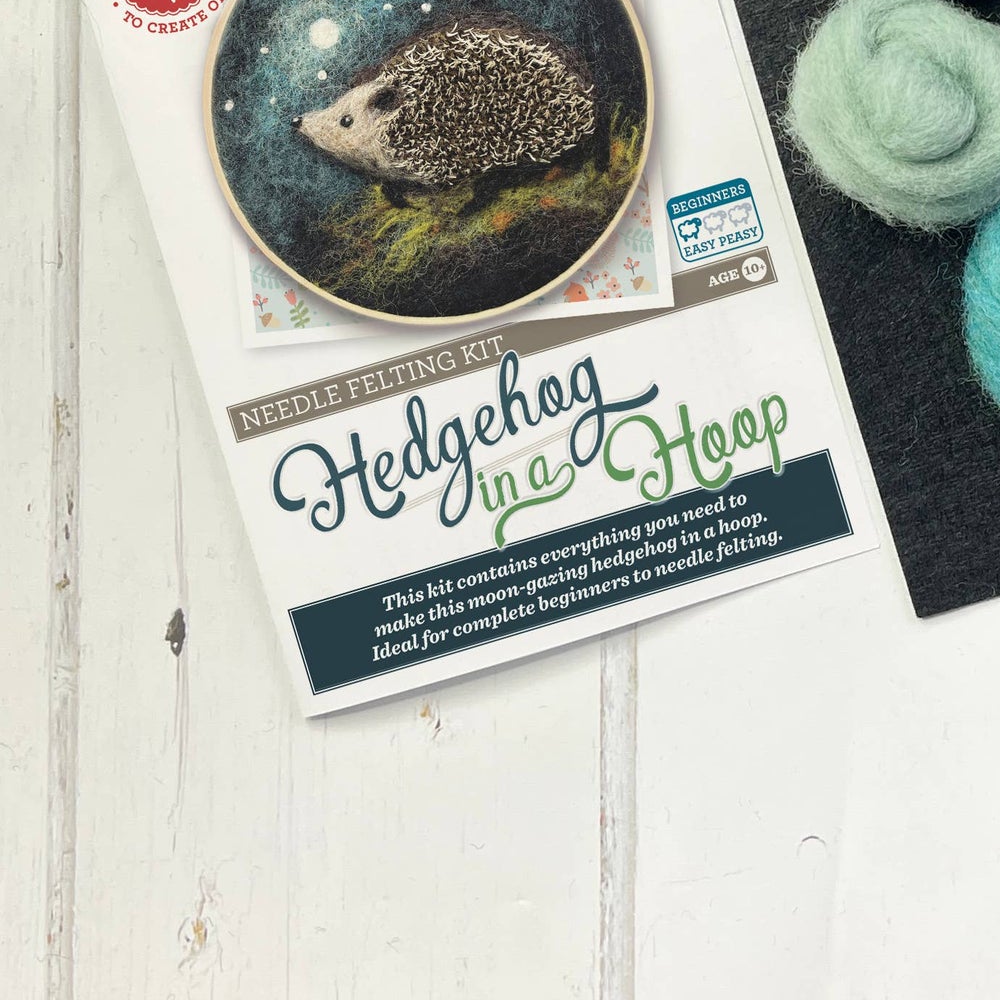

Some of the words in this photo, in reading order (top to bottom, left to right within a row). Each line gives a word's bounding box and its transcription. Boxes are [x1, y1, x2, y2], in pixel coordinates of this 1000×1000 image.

[122, 11, 143, 28] TO
[147, 10, 208, 34] CREATE
[671, 184, 746, 215] BEGINNERS
[683, 239, 716, 257] EASY
[718, 226, 758, 247] PEASY
[708, 268, 740, 287] AGE
[743, 263, 766, 276] 10+
[239, 384, 342, 431] NEEDLE
[346, 351, 457, 399] FELTING
[460, 335, 504, 365] KIT
[273, 350, 659, 532] Hedgehog
[476, 468, 518, 513] in
[602, 393, 788, 502] Hoop
[372, 633, 420, 662] Ideal
[421, 627, 450, 651] for
[452, 604, 536, 638] complete
[538, 573, 630, 611] beginners
[633, 568, 652, 584] to
[654, 548, 714, 577] needle
[715, 529, 783, 563] felting.
[374, 612, 426, 638] make
[428, 599, 465, 622] this
[468, 563, 588, 610] moon-gazing
[591, 537, 677, 573] hedgehog
[680, 530, 701, 547] in
[703, 526, 717, 540] a
[717, 511, 768, 535] hoop.
[382, 588, 425, 612] This
[427, 579, 454, 600] kit
[456, 555, 538, 590] contains
[541, 524, 641, 565] everything
[644, 512, 680, 537] you
[682, 498, 727, 523] need
[730, 493, 748, 510] to
